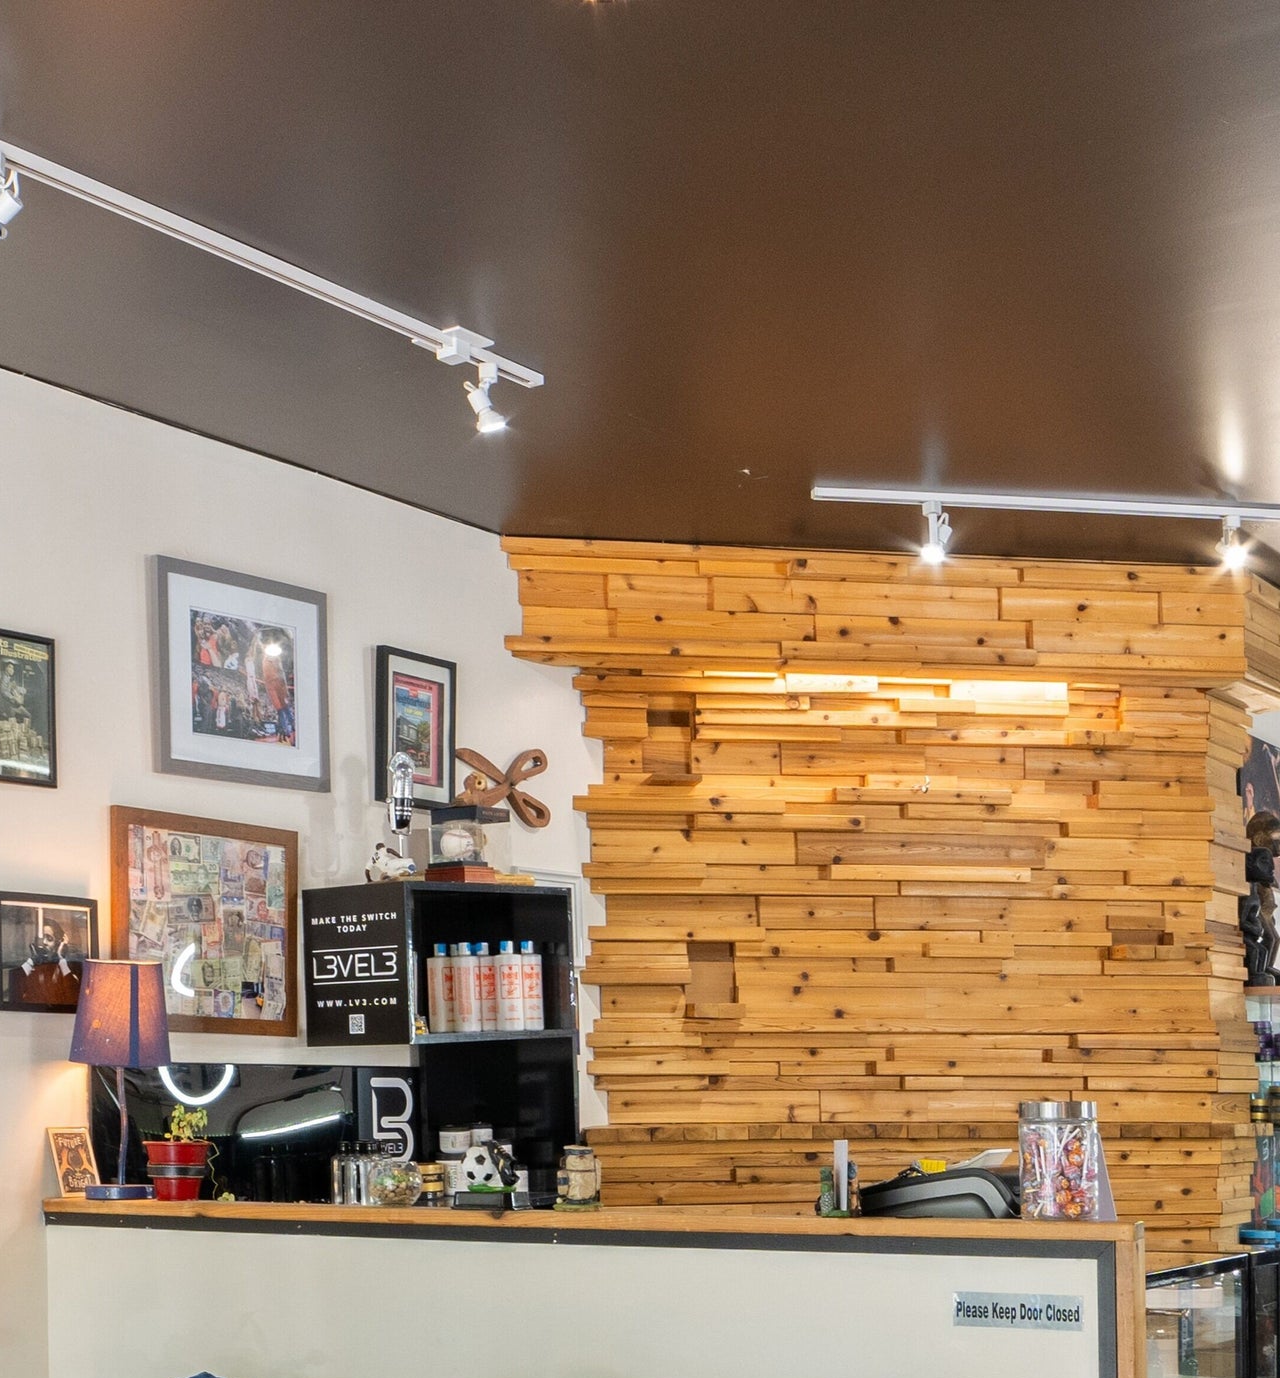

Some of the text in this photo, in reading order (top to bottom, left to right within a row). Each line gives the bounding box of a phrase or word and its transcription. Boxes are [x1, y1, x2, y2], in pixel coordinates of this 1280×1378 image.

[311, 912, 397, 925] MAKE THE SWITCH
[336, 924, 368, 933] TODAY
[317, 997, 397, 1008] WWW.LV3.COM
[956, 1301, 1080, 1324] Please Keep Door Closed
